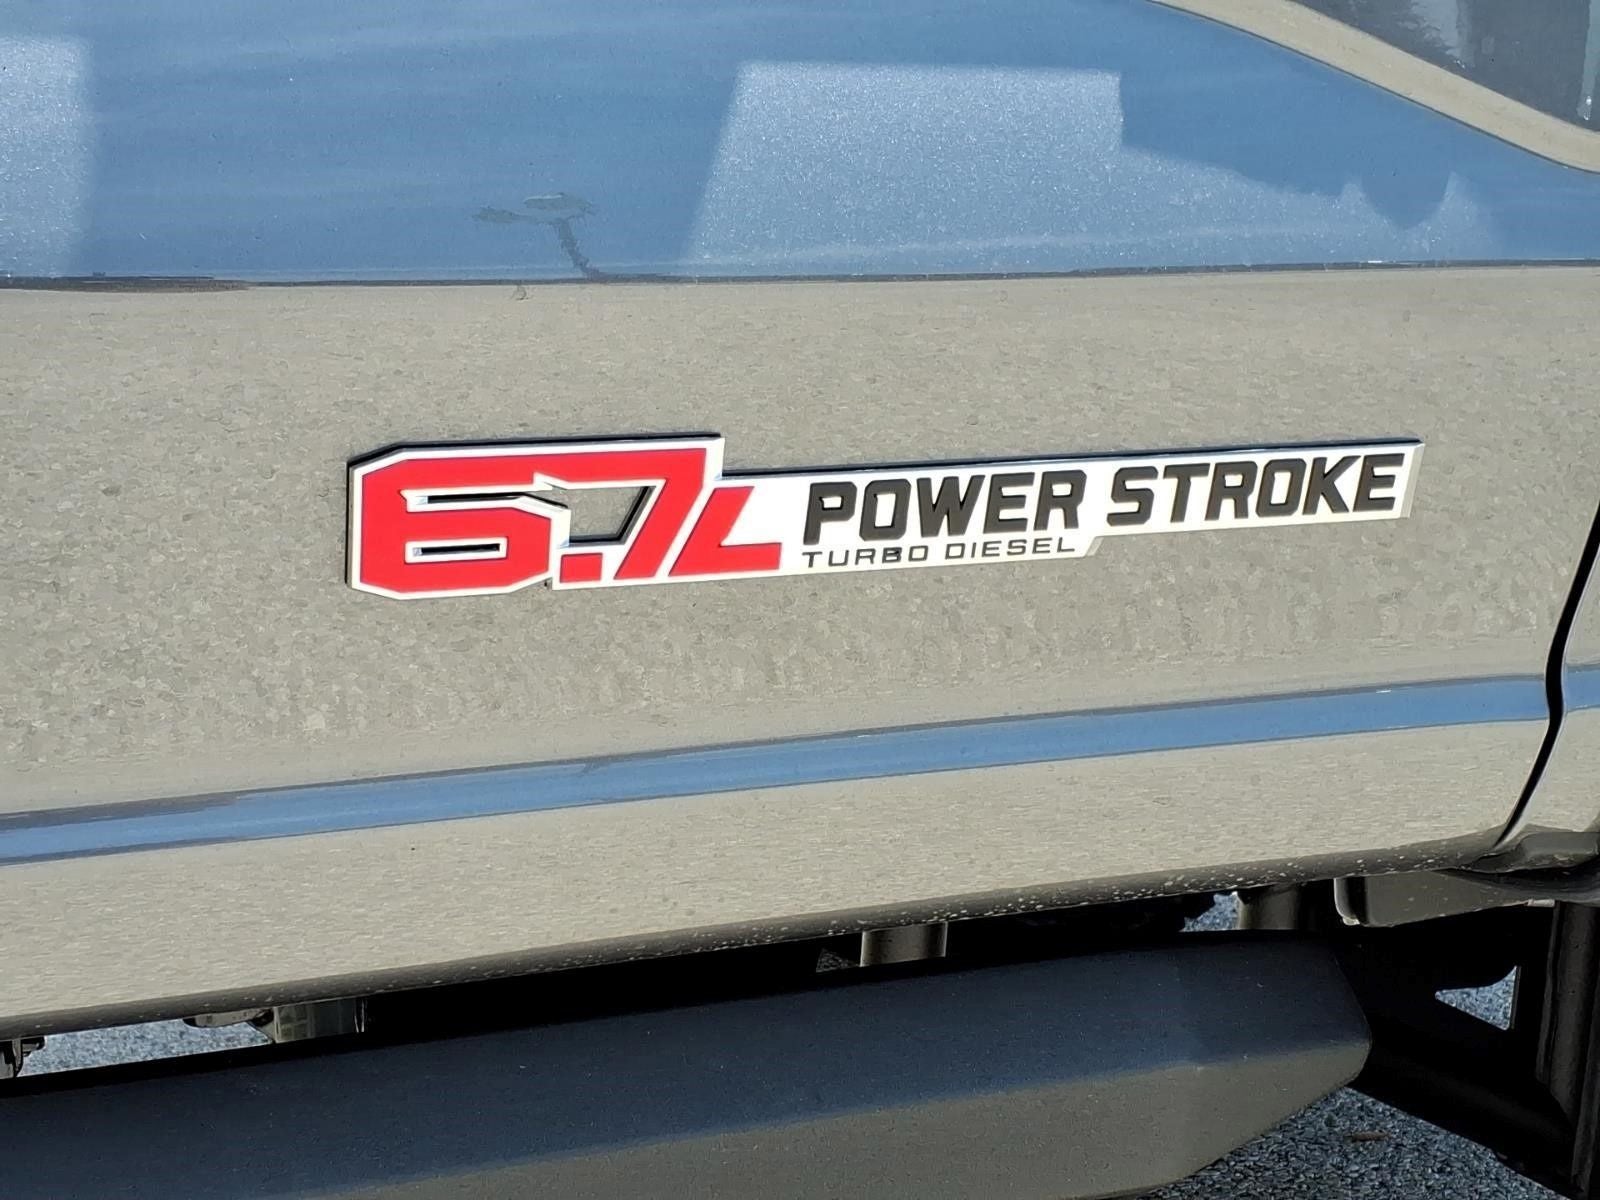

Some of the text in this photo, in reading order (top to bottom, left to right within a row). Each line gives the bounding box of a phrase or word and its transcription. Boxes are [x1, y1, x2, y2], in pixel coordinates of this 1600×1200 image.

[360, 448, 1405, 593] 6.7L POWER STROKE
[802, 537, 1075, 568] TURBO DIESEL
